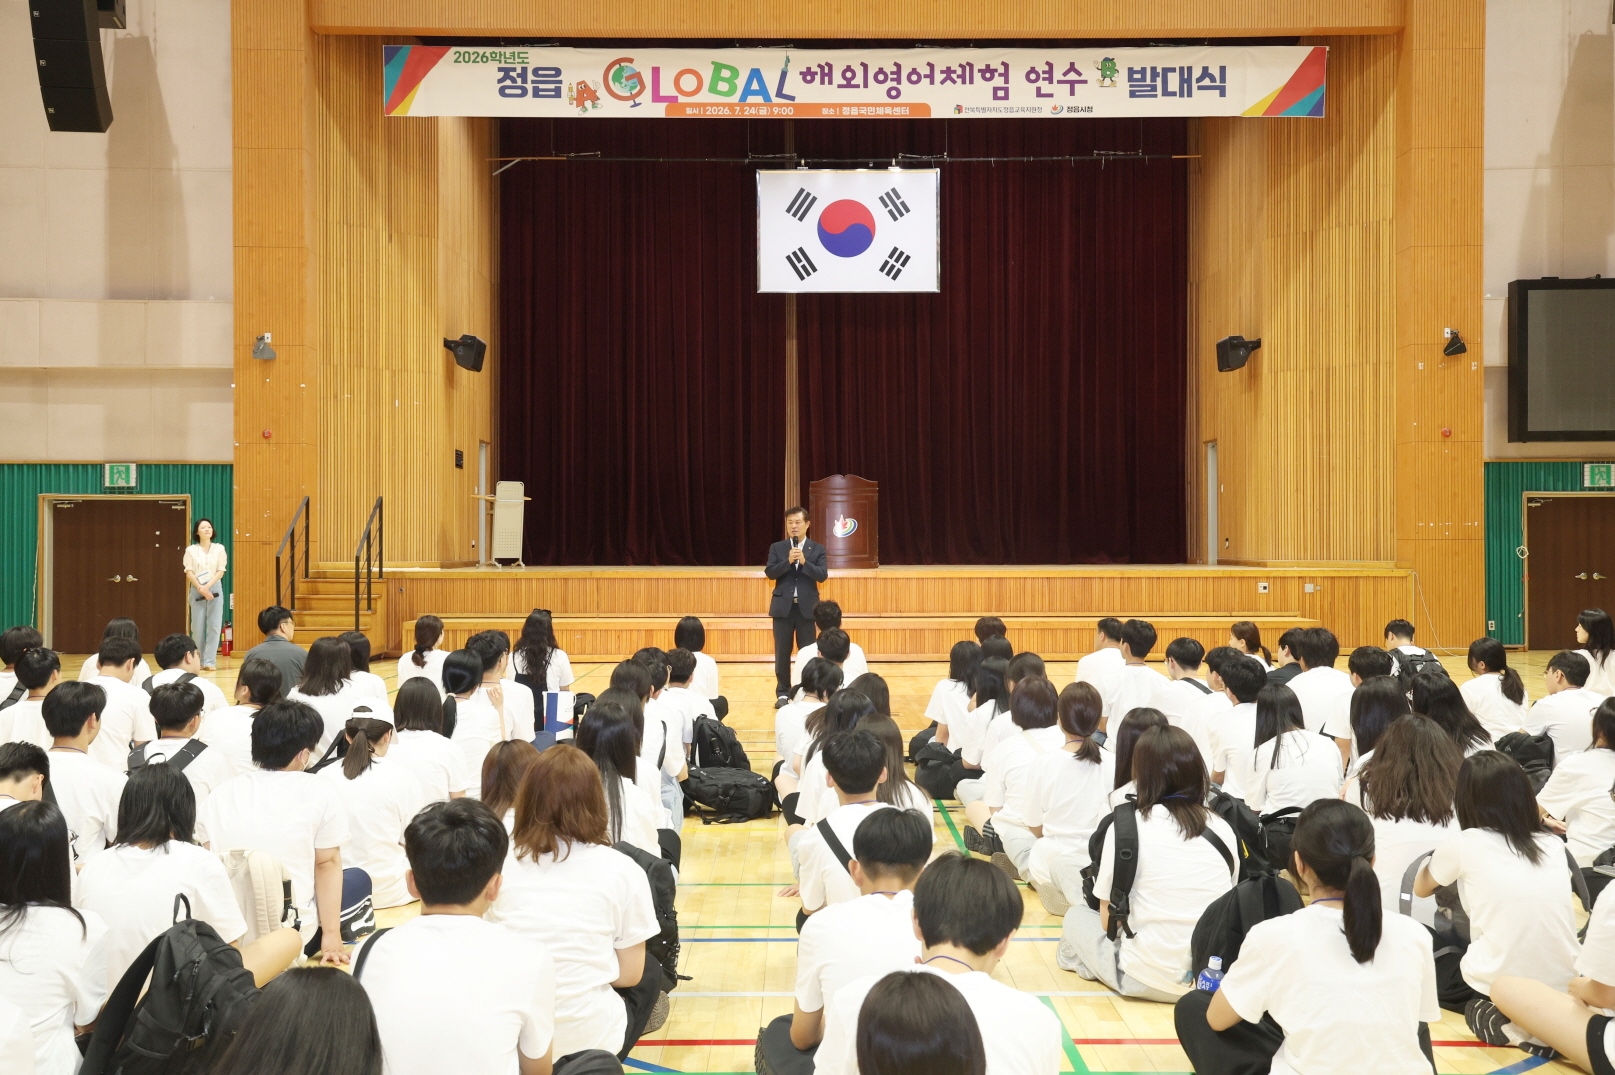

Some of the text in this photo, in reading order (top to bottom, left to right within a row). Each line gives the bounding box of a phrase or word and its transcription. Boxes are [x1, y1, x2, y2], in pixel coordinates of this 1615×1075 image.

[453, 51, 530, 65] 2026학년도
[497, 55, 1227, 105] 정읍 GLOBAL 해외영어체험 연수 발대식
[685, 106, 794, 116] 일시 2026. 7. 24(금) 9:00
[822, 106, 910, 116] 장소 정읍국민체육센터
[1066, 105, 1094, 114] 정읍시청
